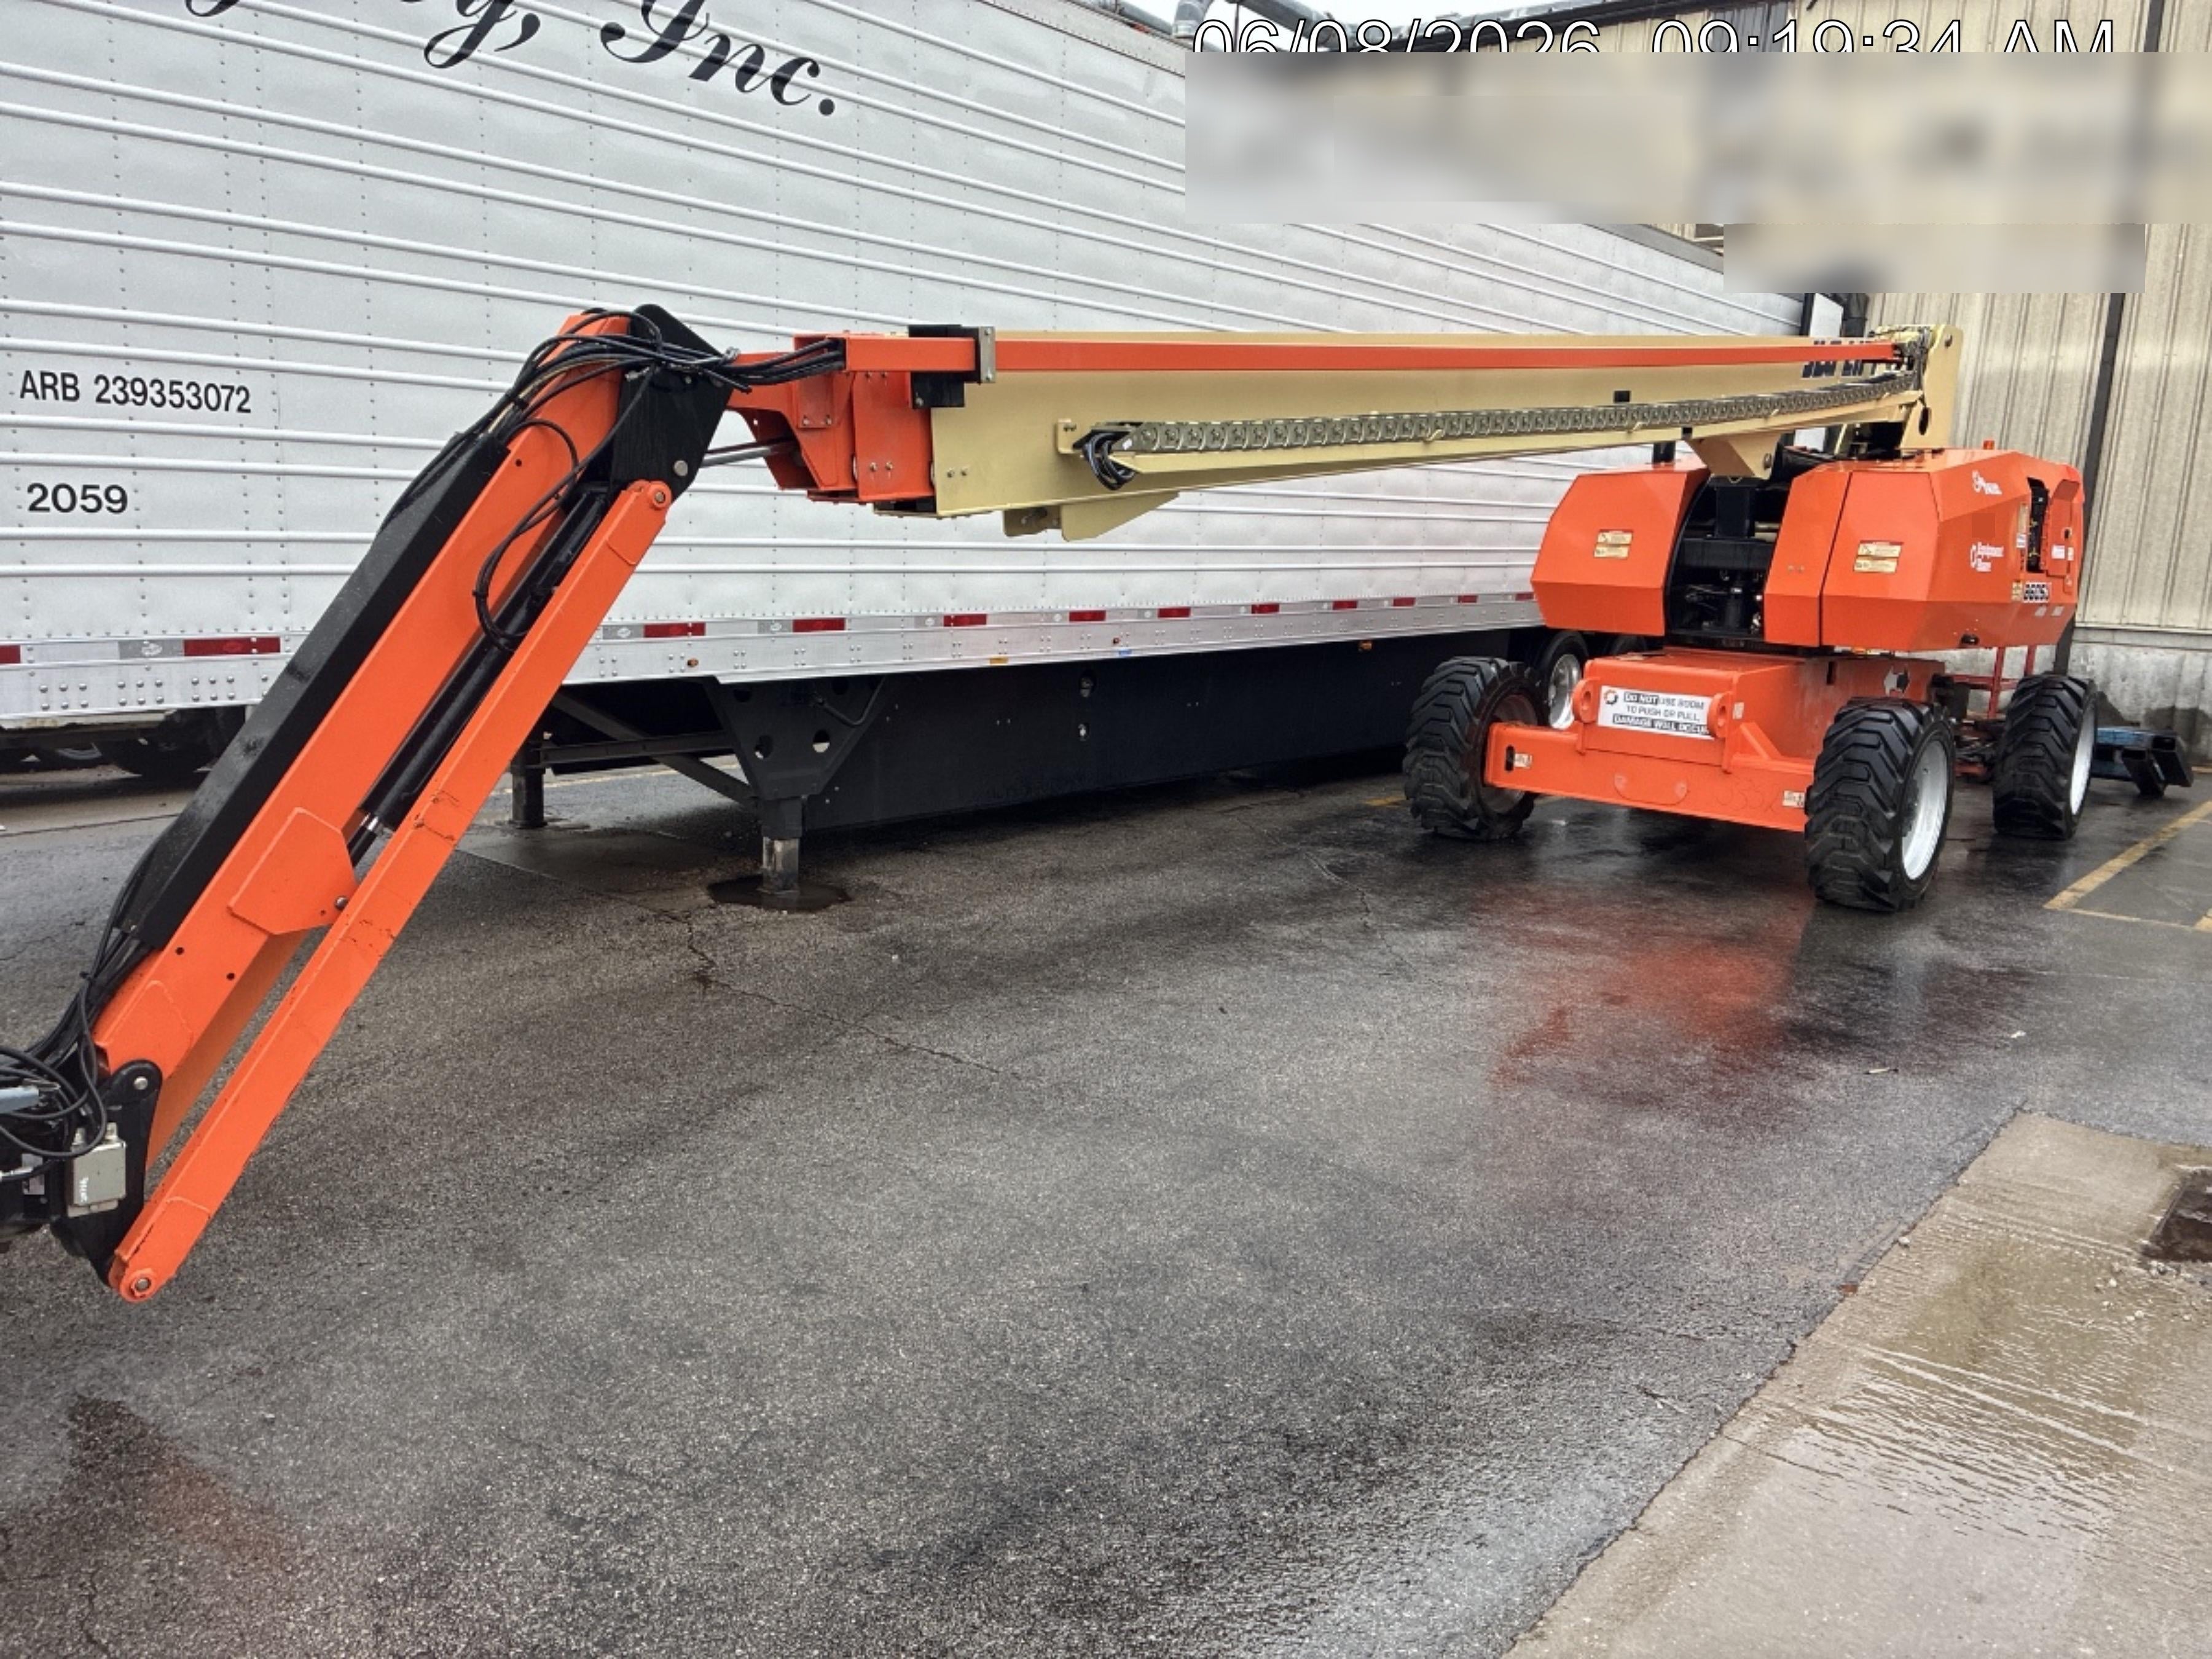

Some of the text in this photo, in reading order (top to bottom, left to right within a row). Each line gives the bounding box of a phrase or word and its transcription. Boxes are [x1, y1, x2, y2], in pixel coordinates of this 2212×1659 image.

[20, 370, 251, 413] ARB 239353072
[27, 482, 128, 514] 2059
[1639, 695, 1658, 705] NOT
[1638, 706, 1661, 716] PUSH
[1677, 712, 1700, 721] PULL
